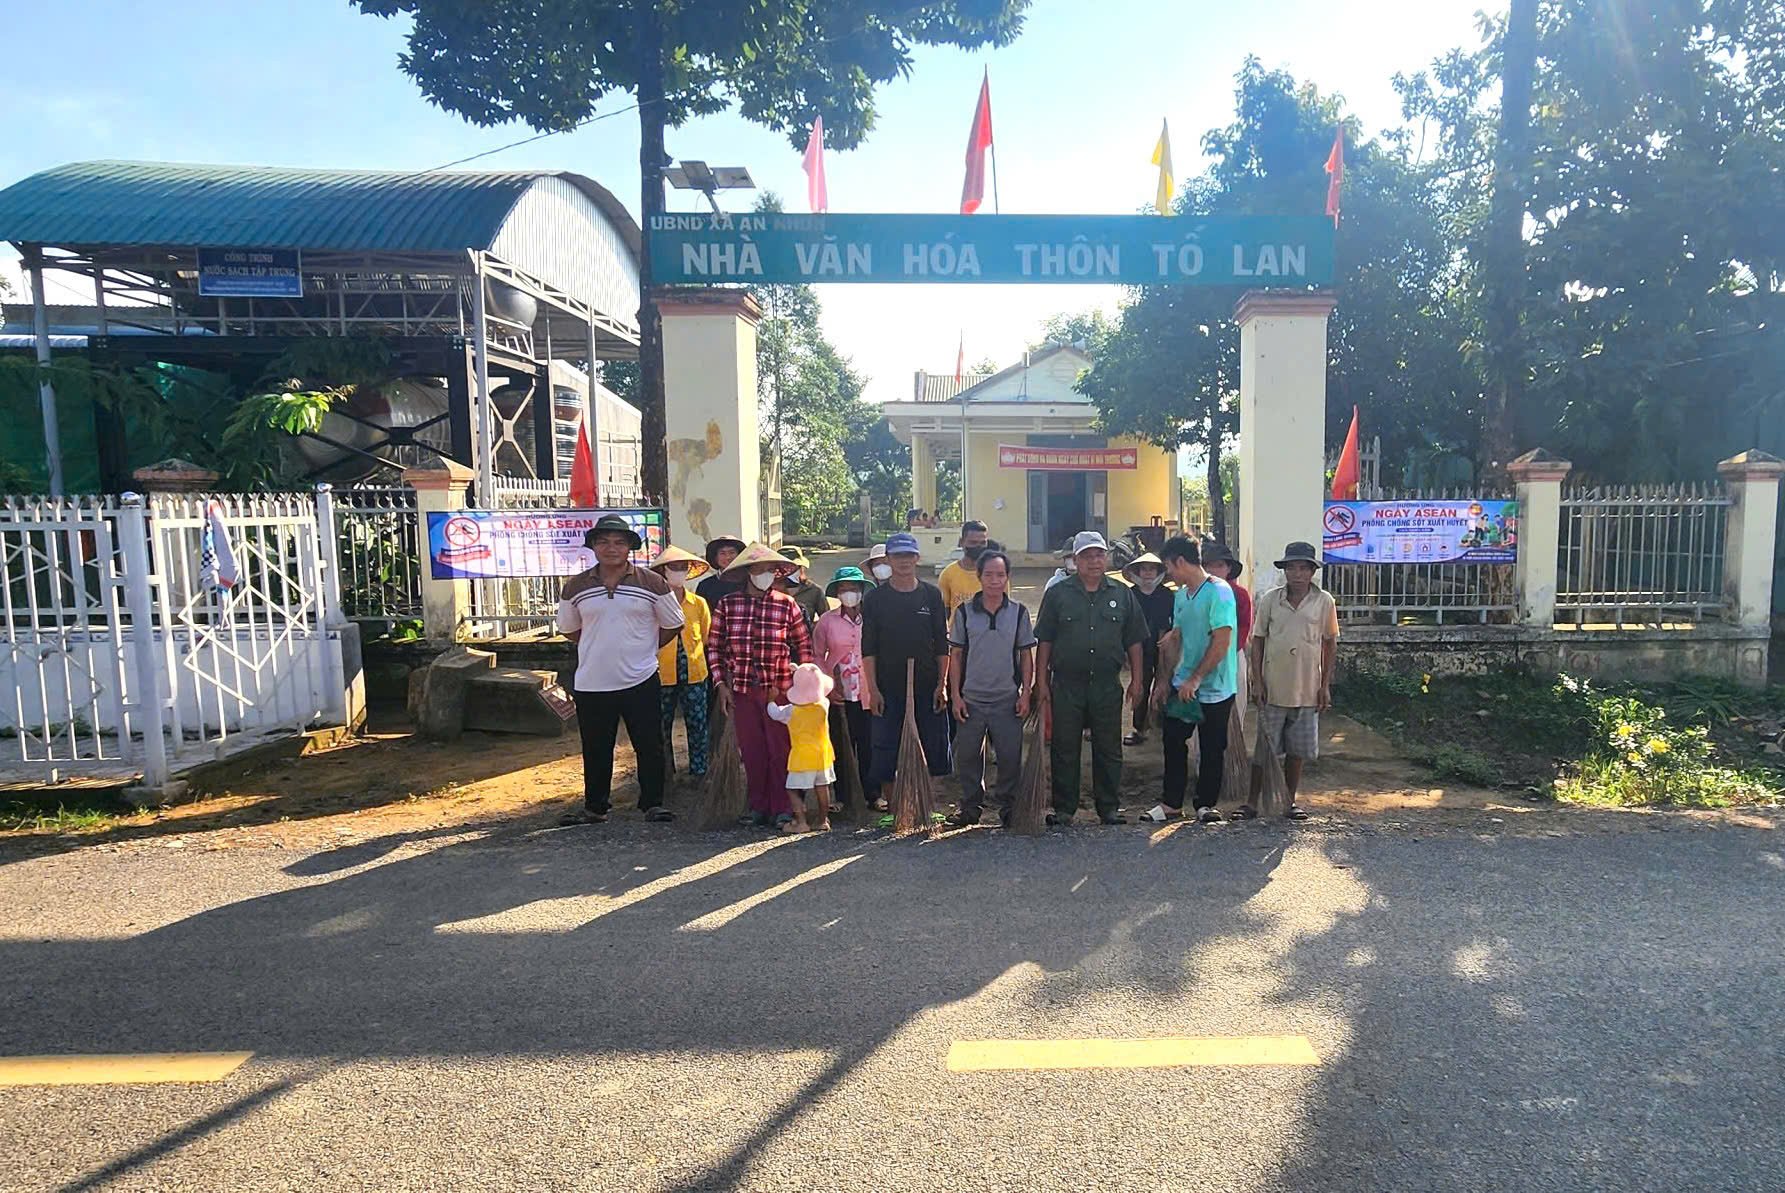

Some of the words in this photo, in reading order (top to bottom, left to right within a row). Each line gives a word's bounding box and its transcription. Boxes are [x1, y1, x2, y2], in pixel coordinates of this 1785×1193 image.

[650, 216, 703, 231] UBND
[682, 235, 764, 275] NHÀ
[795, 235, 872, 275] VĂN
[903, 231, 981, 275] HÓA
[1014, 234, 1120, 276] THÔN
[1152, 224, 1207, 276] TỐ
[1233, 244, 1306, 276] LAN
[269, 267, 296, 277] TRUNG
[1376, 508, 1410, 518] NGÀY
[1414, 508, 1457, 518] ASEAN
[548, 519, 593, 529] ASEAN
